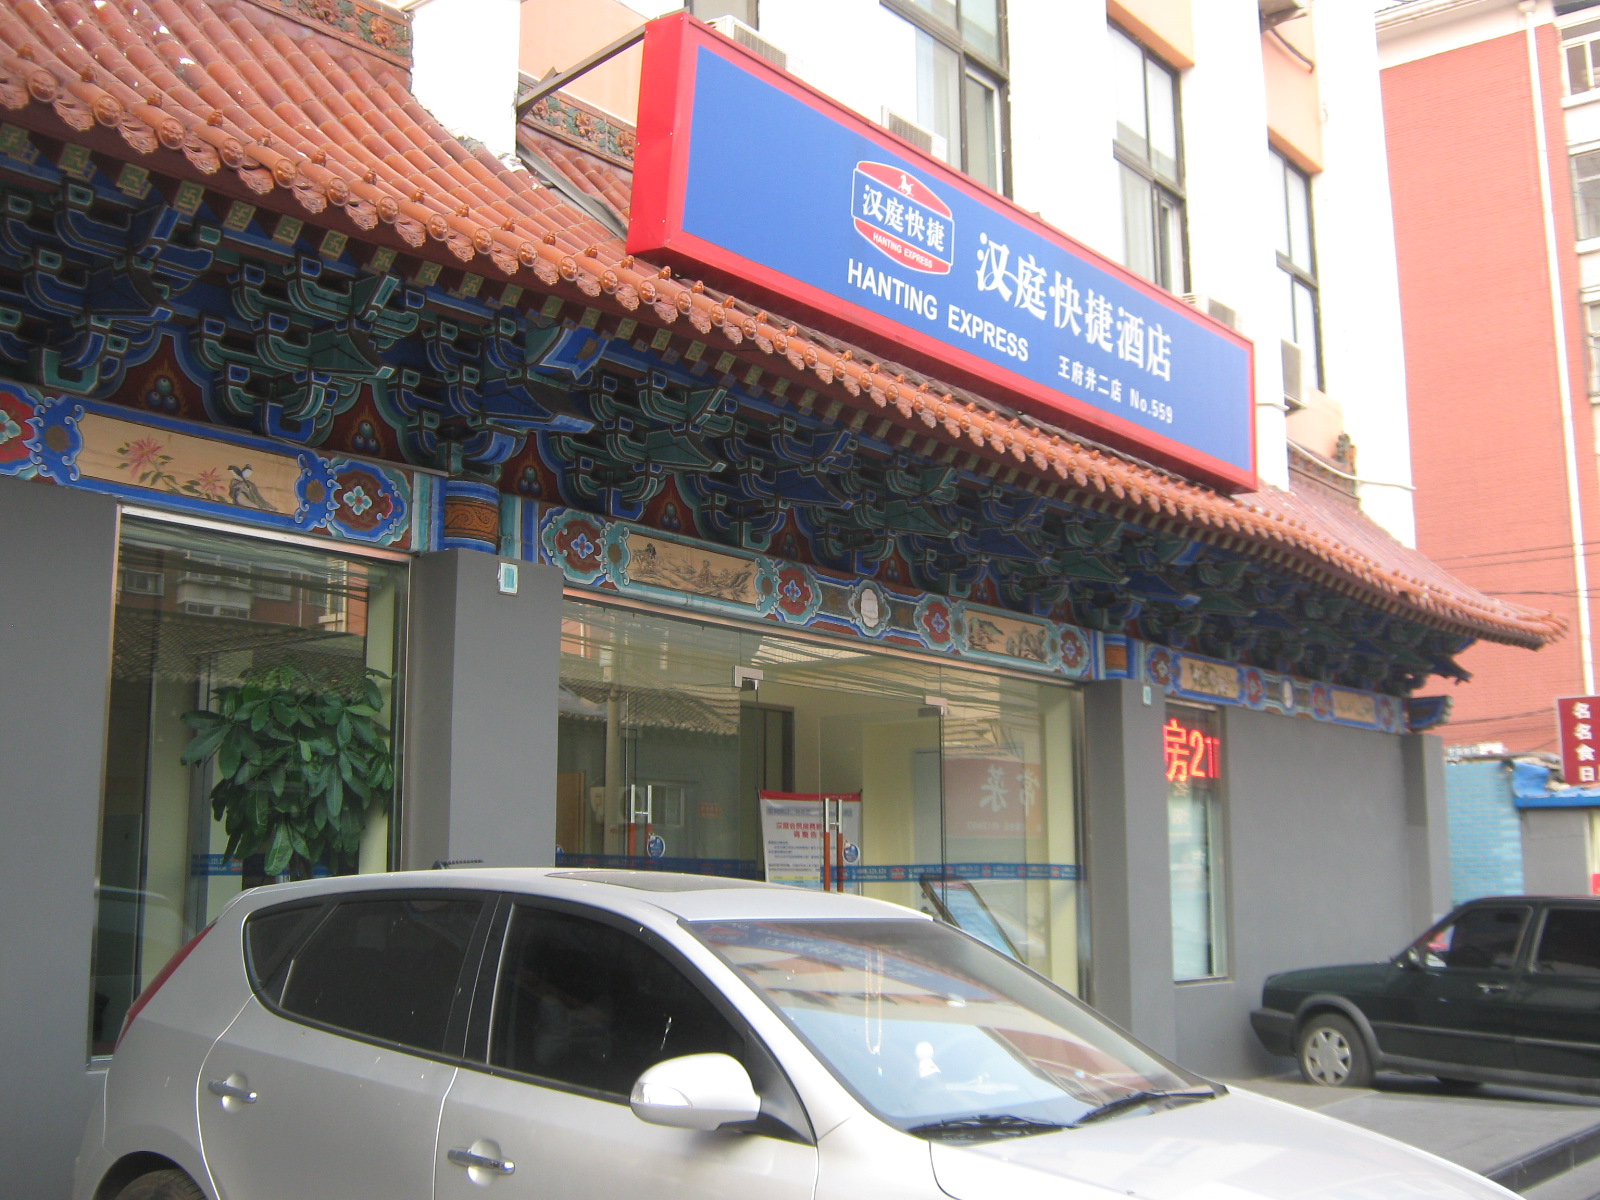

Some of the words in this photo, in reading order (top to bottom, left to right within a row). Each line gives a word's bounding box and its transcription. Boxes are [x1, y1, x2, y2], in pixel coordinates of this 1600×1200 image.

[862, 184, 945, 252] 汉庭快捷
[872, 231, 903, 255] HANTING
[903, 248, 933, 270] EXPRESS
[847, 258, 938, 321] HANTING
[948, 304, 1029, 362] EXPRESS
[975, 232, 1172, 382] 汉庭快捷酒店
[1058, 355, 1122, 403] 王府井二店
[1129, 388, 1173, 424] No.559
